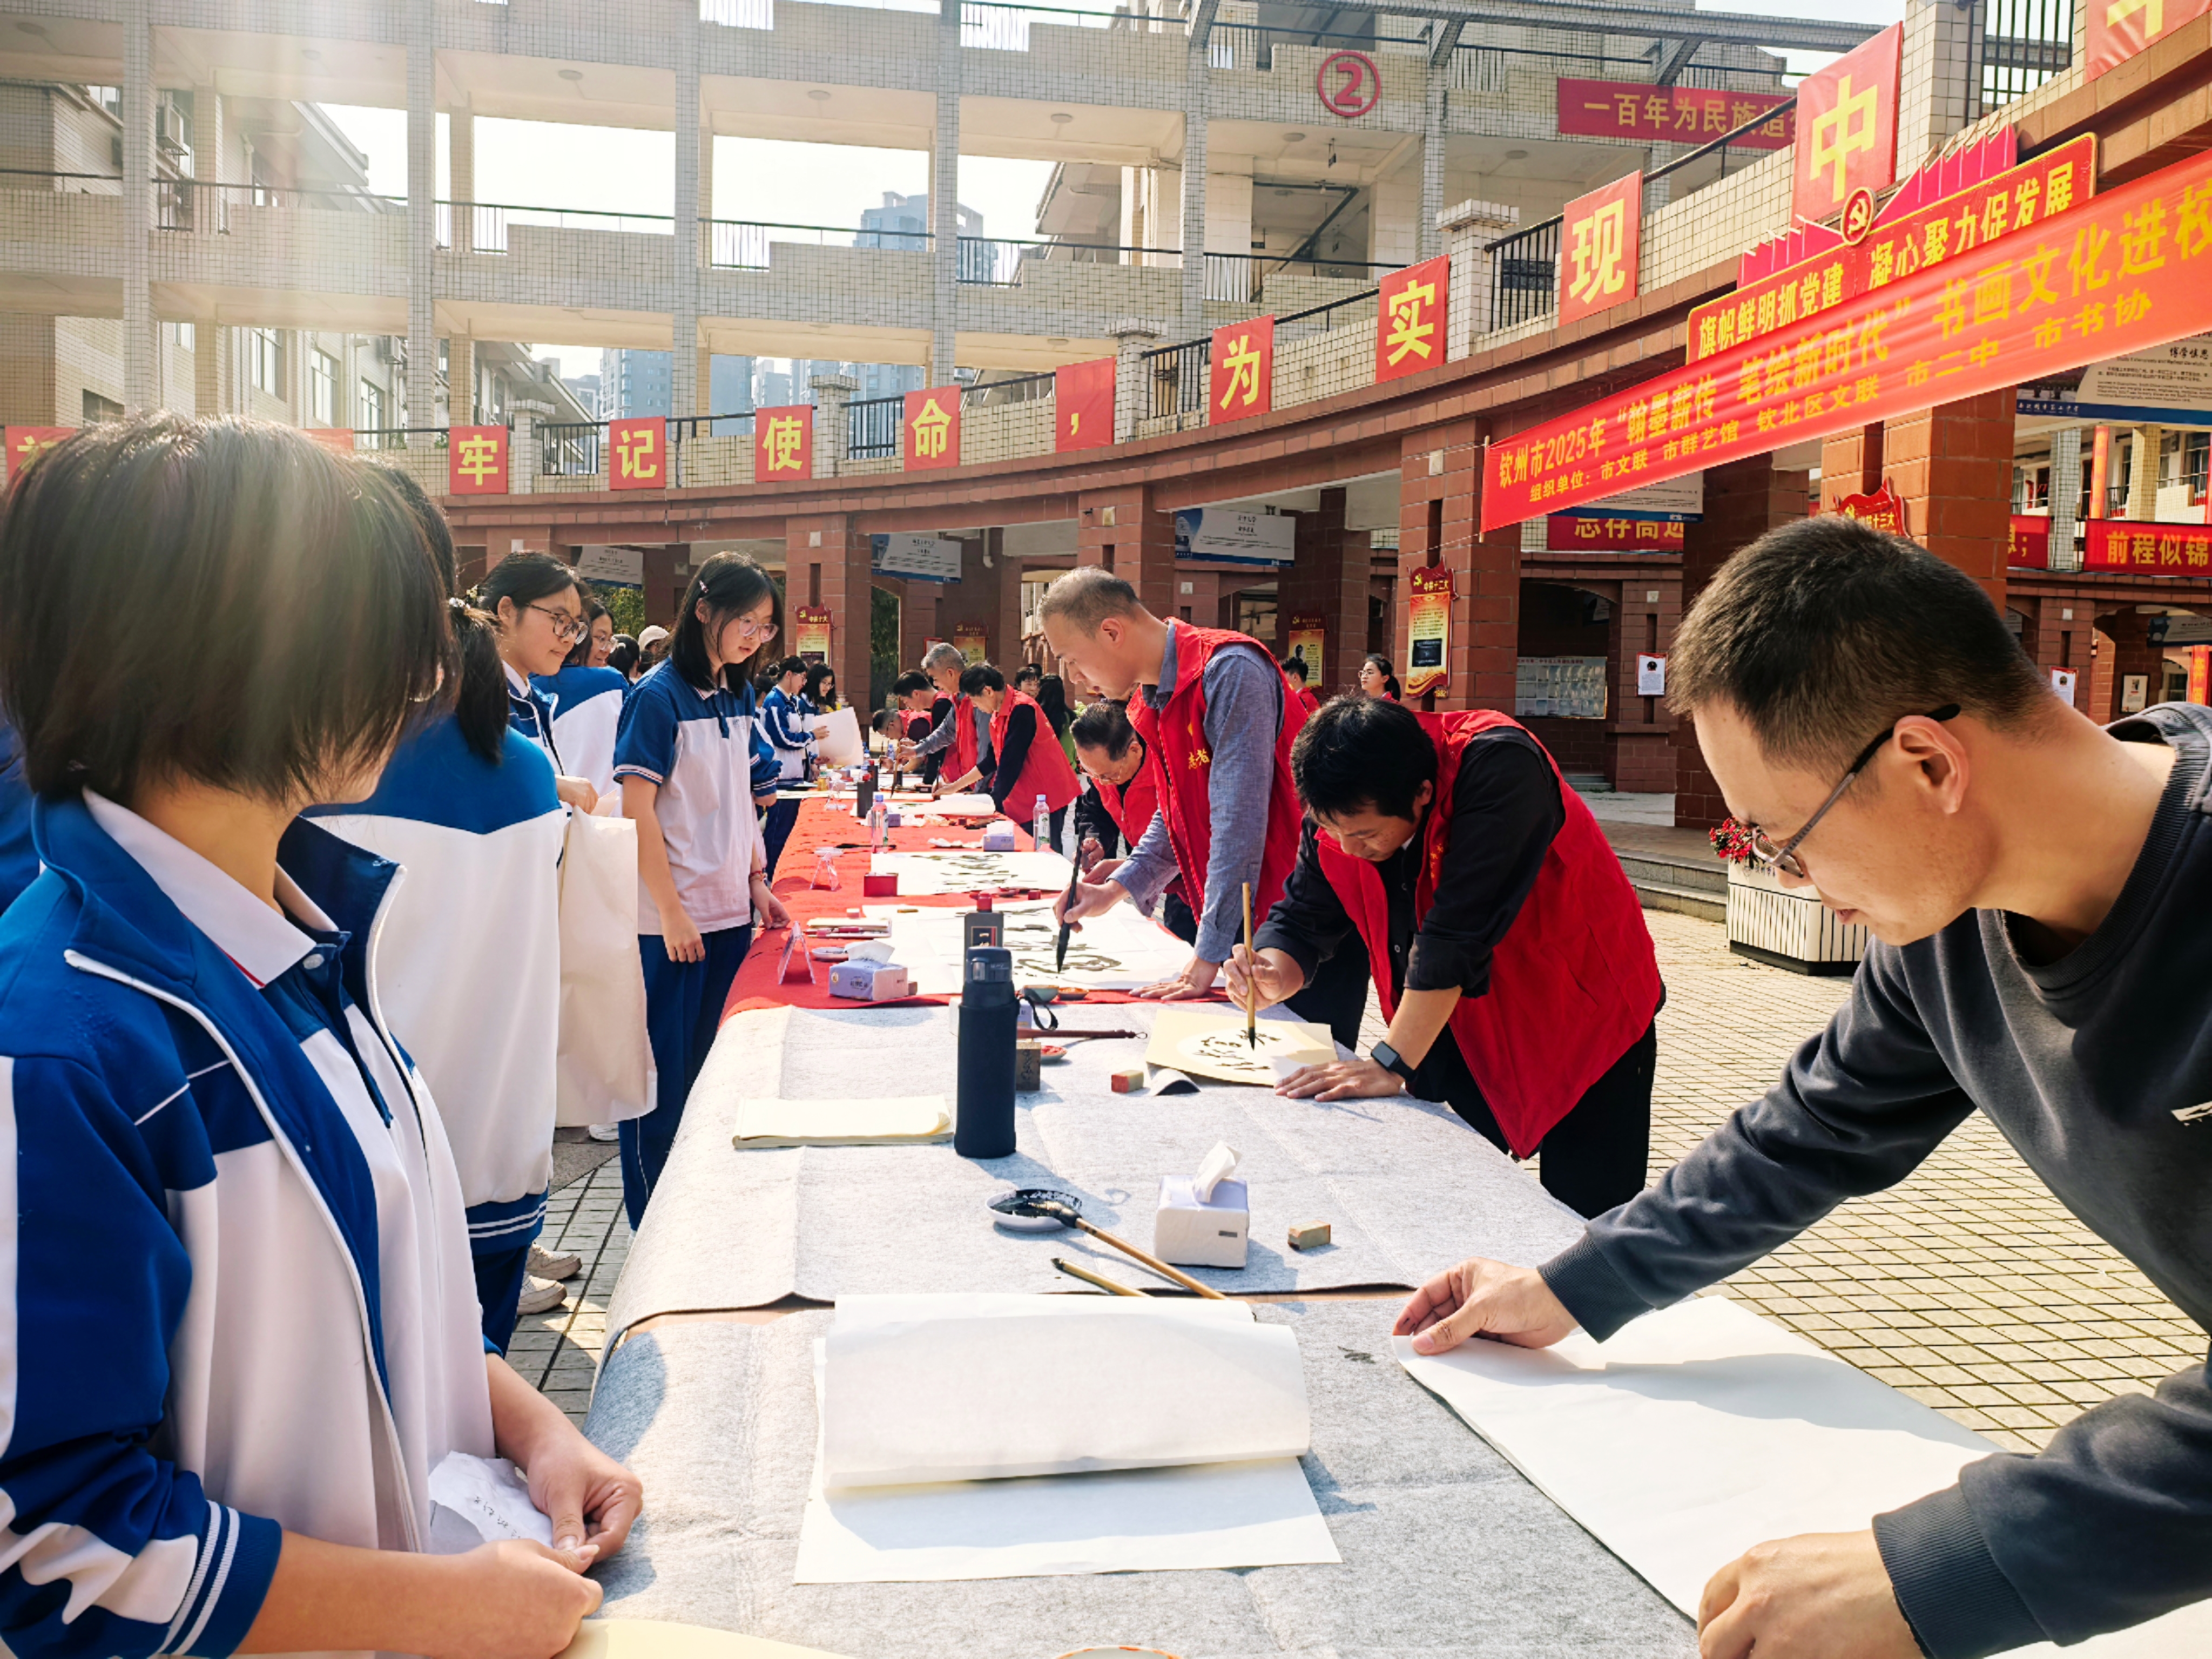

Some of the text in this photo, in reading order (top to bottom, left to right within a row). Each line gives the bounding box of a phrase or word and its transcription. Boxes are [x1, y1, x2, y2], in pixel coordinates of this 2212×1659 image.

[1809, 75, 1877, 204] 中
[1568, 198, 1625, 305] 现
[1698, 161, 2073, 360] 旗帜鲜明抓党建 凝心聚力促发展
[1386, 279, 1435, 367] 实
[1219, 334, 1260, 410] 为
[1662, 419, 1739, 461] 市群艺馆
[1756, 374, 1880, 434] 钦北区文联
[1905, 338, 1999, 388] 市二中
[2032, 288, 2153, 349] 市书协
[457, 434, 498, 486] 牢
[616, 429, 658, 478] 记
[762, 415, 803, 471] 使
[911, 397, 952, 458] 命
[2106, 530, 2209, 568] 前程似锦
[1424, 579, 1449, 592] 中共十二大
